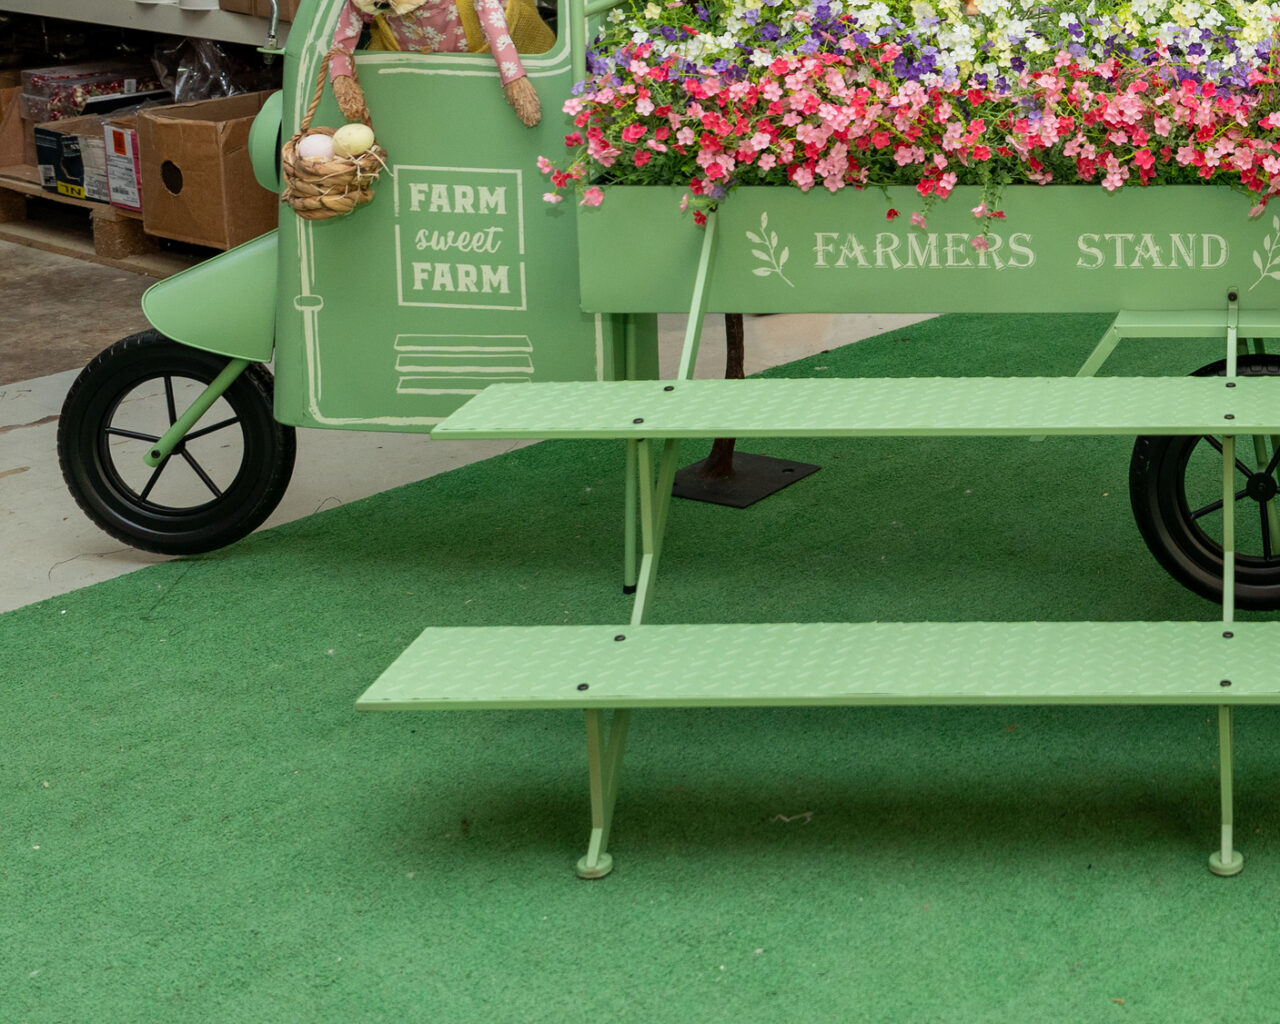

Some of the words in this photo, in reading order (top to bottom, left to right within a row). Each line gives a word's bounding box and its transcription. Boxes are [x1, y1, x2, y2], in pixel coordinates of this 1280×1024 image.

[408, 182, 507, 215] FARM
[415, 226, 504, 254] sweet
[812, 231, 1037, 270] FARMERS
[1075, 232, 1230, 270] STAND
[411, 261, 511, 294] FARM
